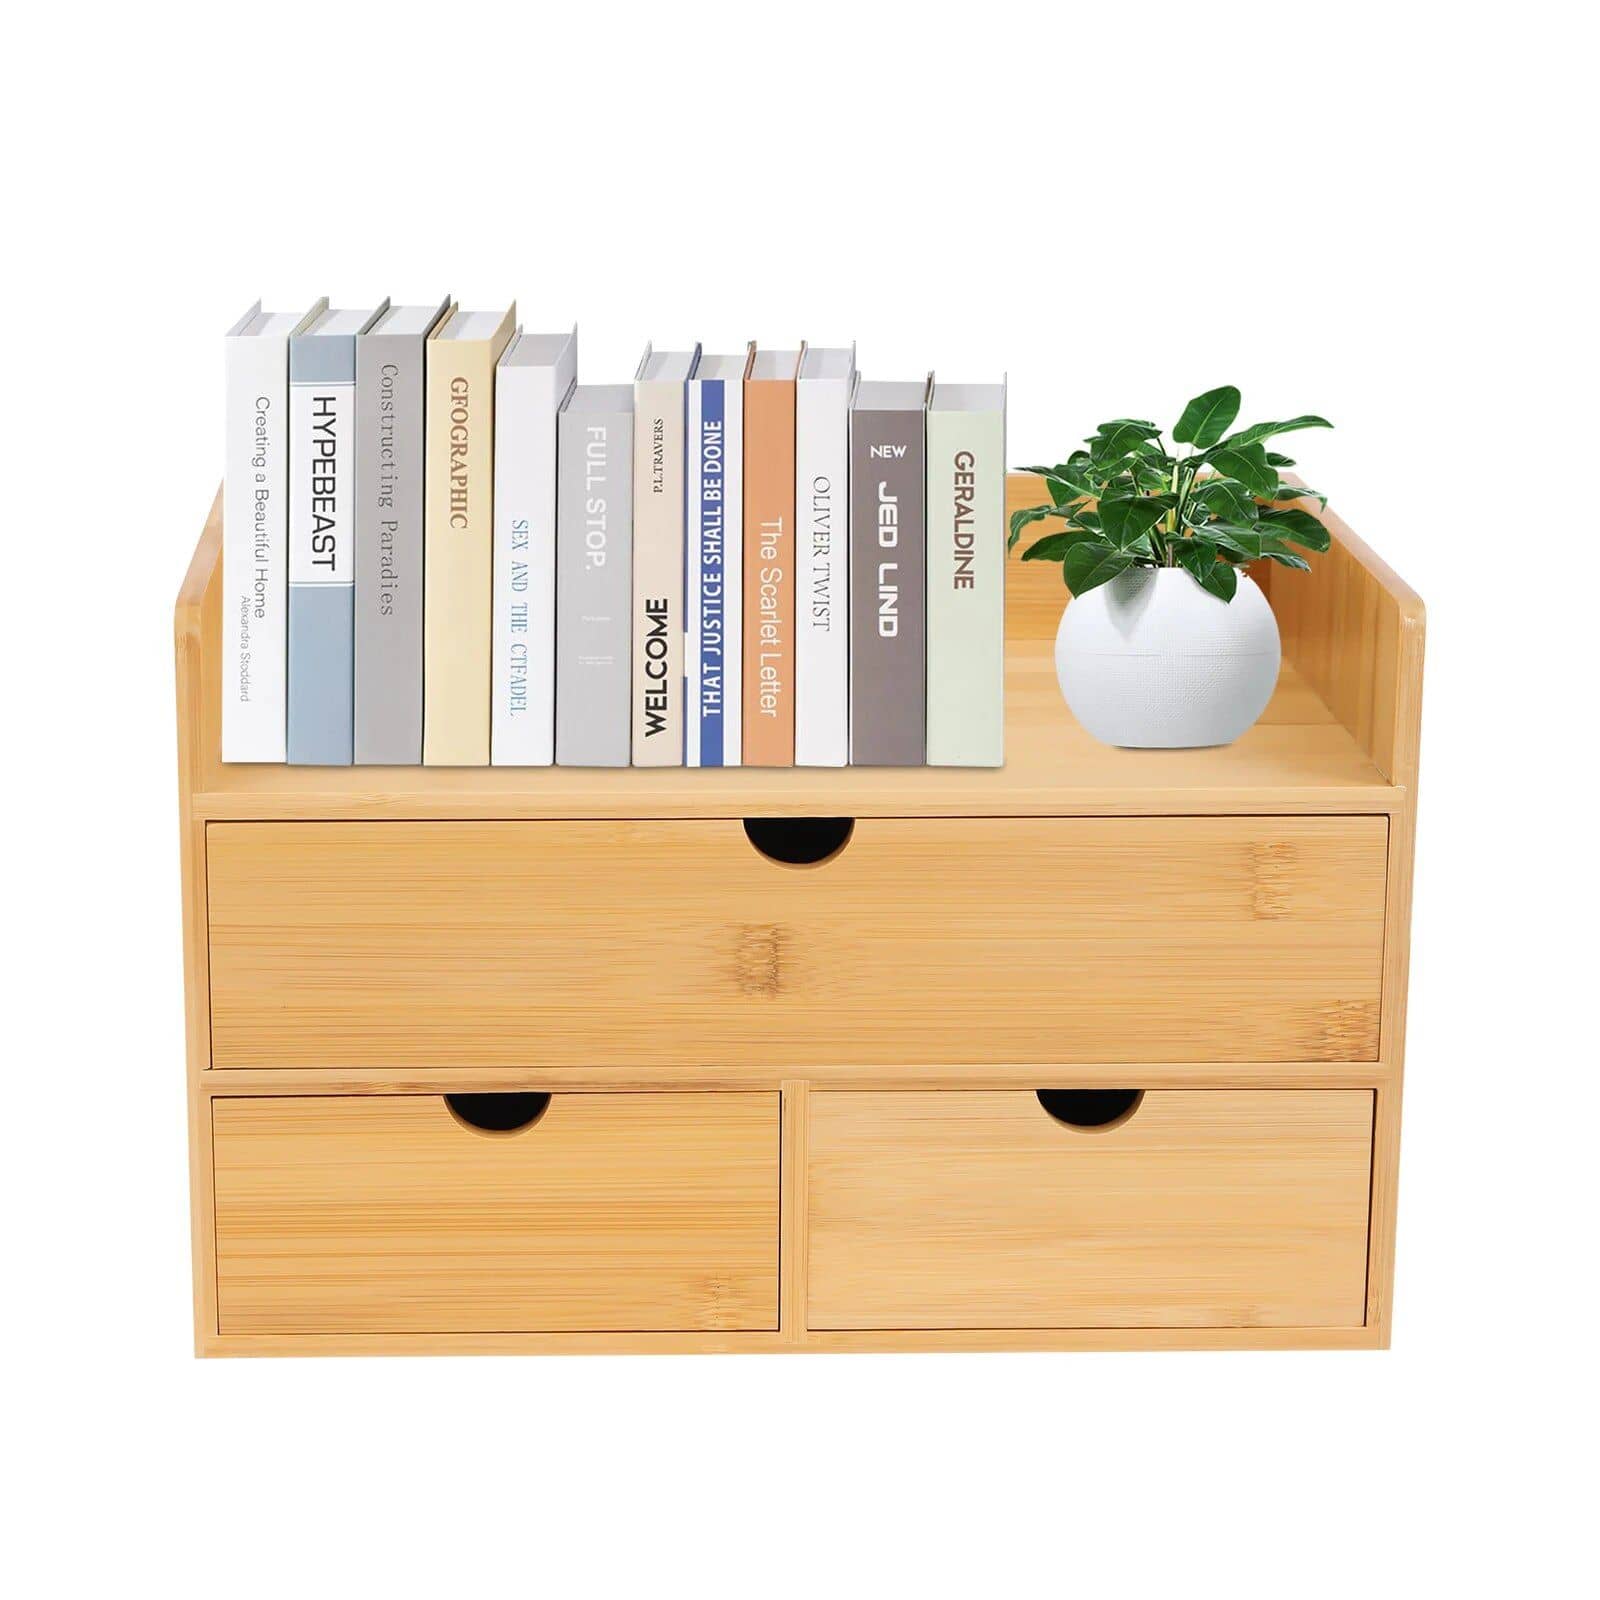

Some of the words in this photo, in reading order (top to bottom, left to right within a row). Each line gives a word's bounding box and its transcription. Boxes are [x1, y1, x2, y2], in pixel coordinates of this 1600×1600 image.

[252, 397, 270, 467] Creating
[378, 365, 398, 507] Constructing
[587, 427, 606, 491] FULL
[704, 421, 722, 473] DONE
[871, 445, 906, 458] NEW
[256, 474, 265, 482] a
[312, 397, 336, 571] HYPEBEAST
[704, 478, 722, 500] BE
[255, 490, 269, 562] Beautiful
[512, 520, 528, 549] SEX
[586, 498, 608, 570] STOP.
[703, 506, 722, 564] SHALL
[761, 517, 782, 559] The
[813, 477, 830, 557] OLIVER
[879, 482, 897, 547] JED
[954, 451, 974, 589] GERALDINE
[255, 569, 268, 618] Home
[380, 521, 398, 615] Paradies
[512, 561, 528, 591] AND
[813, 563, 830, 631] TWIST
[879, 563, 898, 637] LIND
[240, 596, 252, 649] Alexandra
[511, 603, 527, 632] THE
[703, 573, 721, 656] JUSTICE
[760, 568, 782, 645] Scarlet
[240, 651, 251, 702] Stoddard
[645, 599, 667, 737] WELCOME
[703, 662, 721, 717] THAT
[760, 653, 781, 717] Letter
